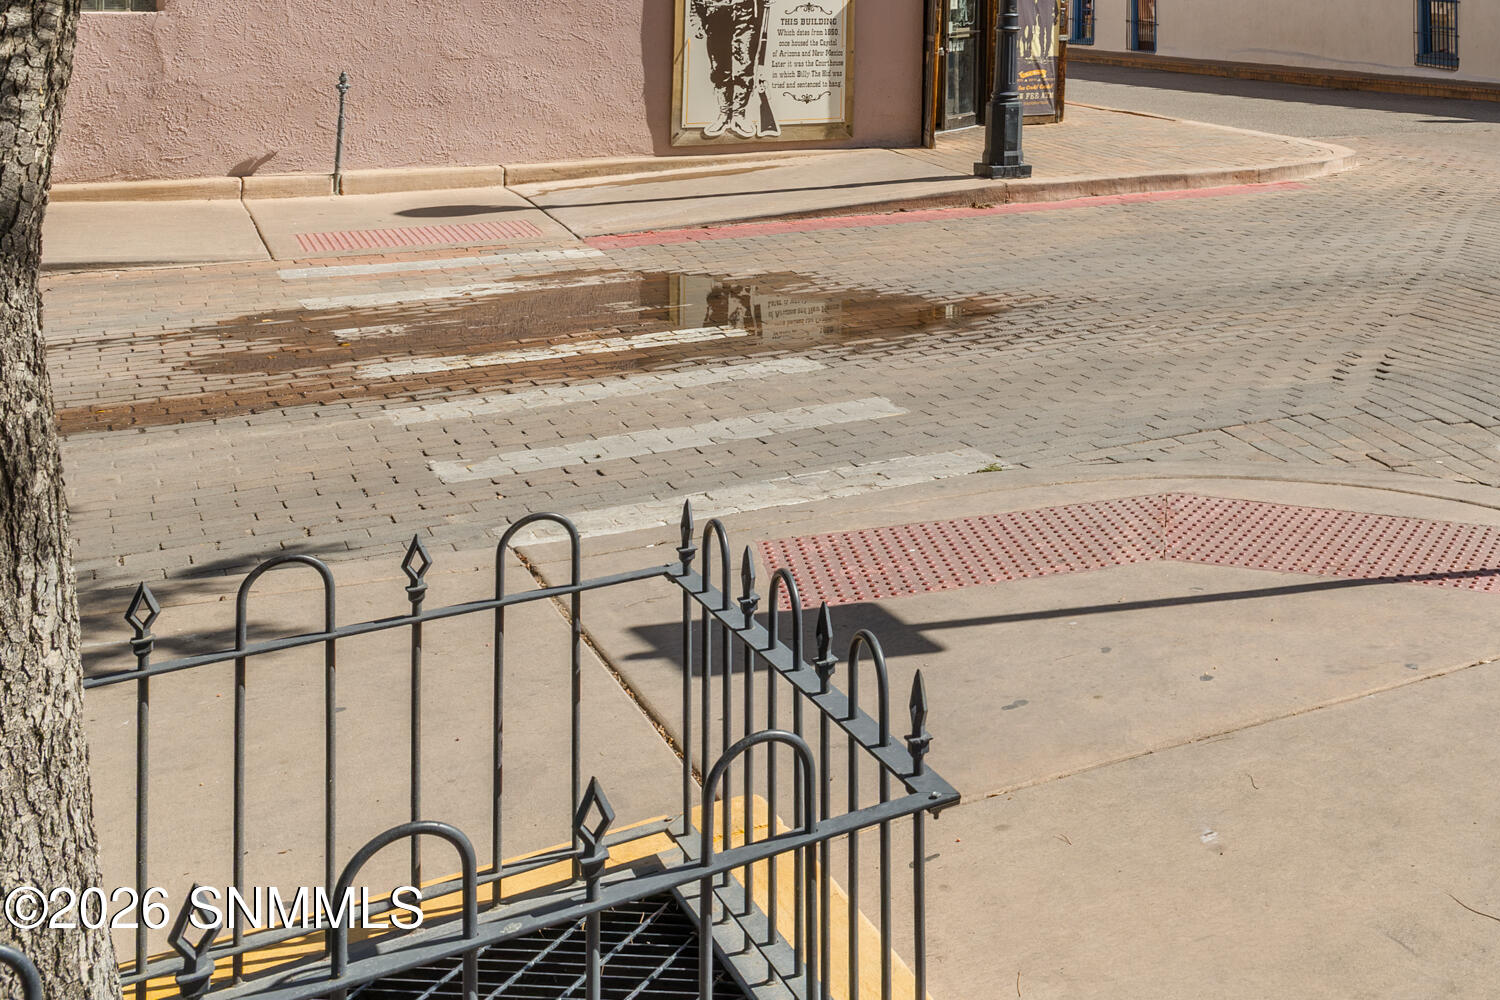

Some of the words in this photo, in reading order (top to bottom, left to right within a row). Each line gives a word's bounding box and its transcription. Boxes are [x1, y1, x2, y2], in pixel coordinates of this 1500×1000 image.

[777, 28, 795, 36] Which
[811, 28, 823, 36] from
[791, 39, 809, 47] housed
[772, 49, 778, 57] of
[779, 49, 800, 57] Arizona
[801, 49, 811, 57] and
[812, 49, 824, 57] New
[779, 70, 796, 78] which
[797, 70, 810, 78] Billy
[796, 80, 821, 88] sentenced
